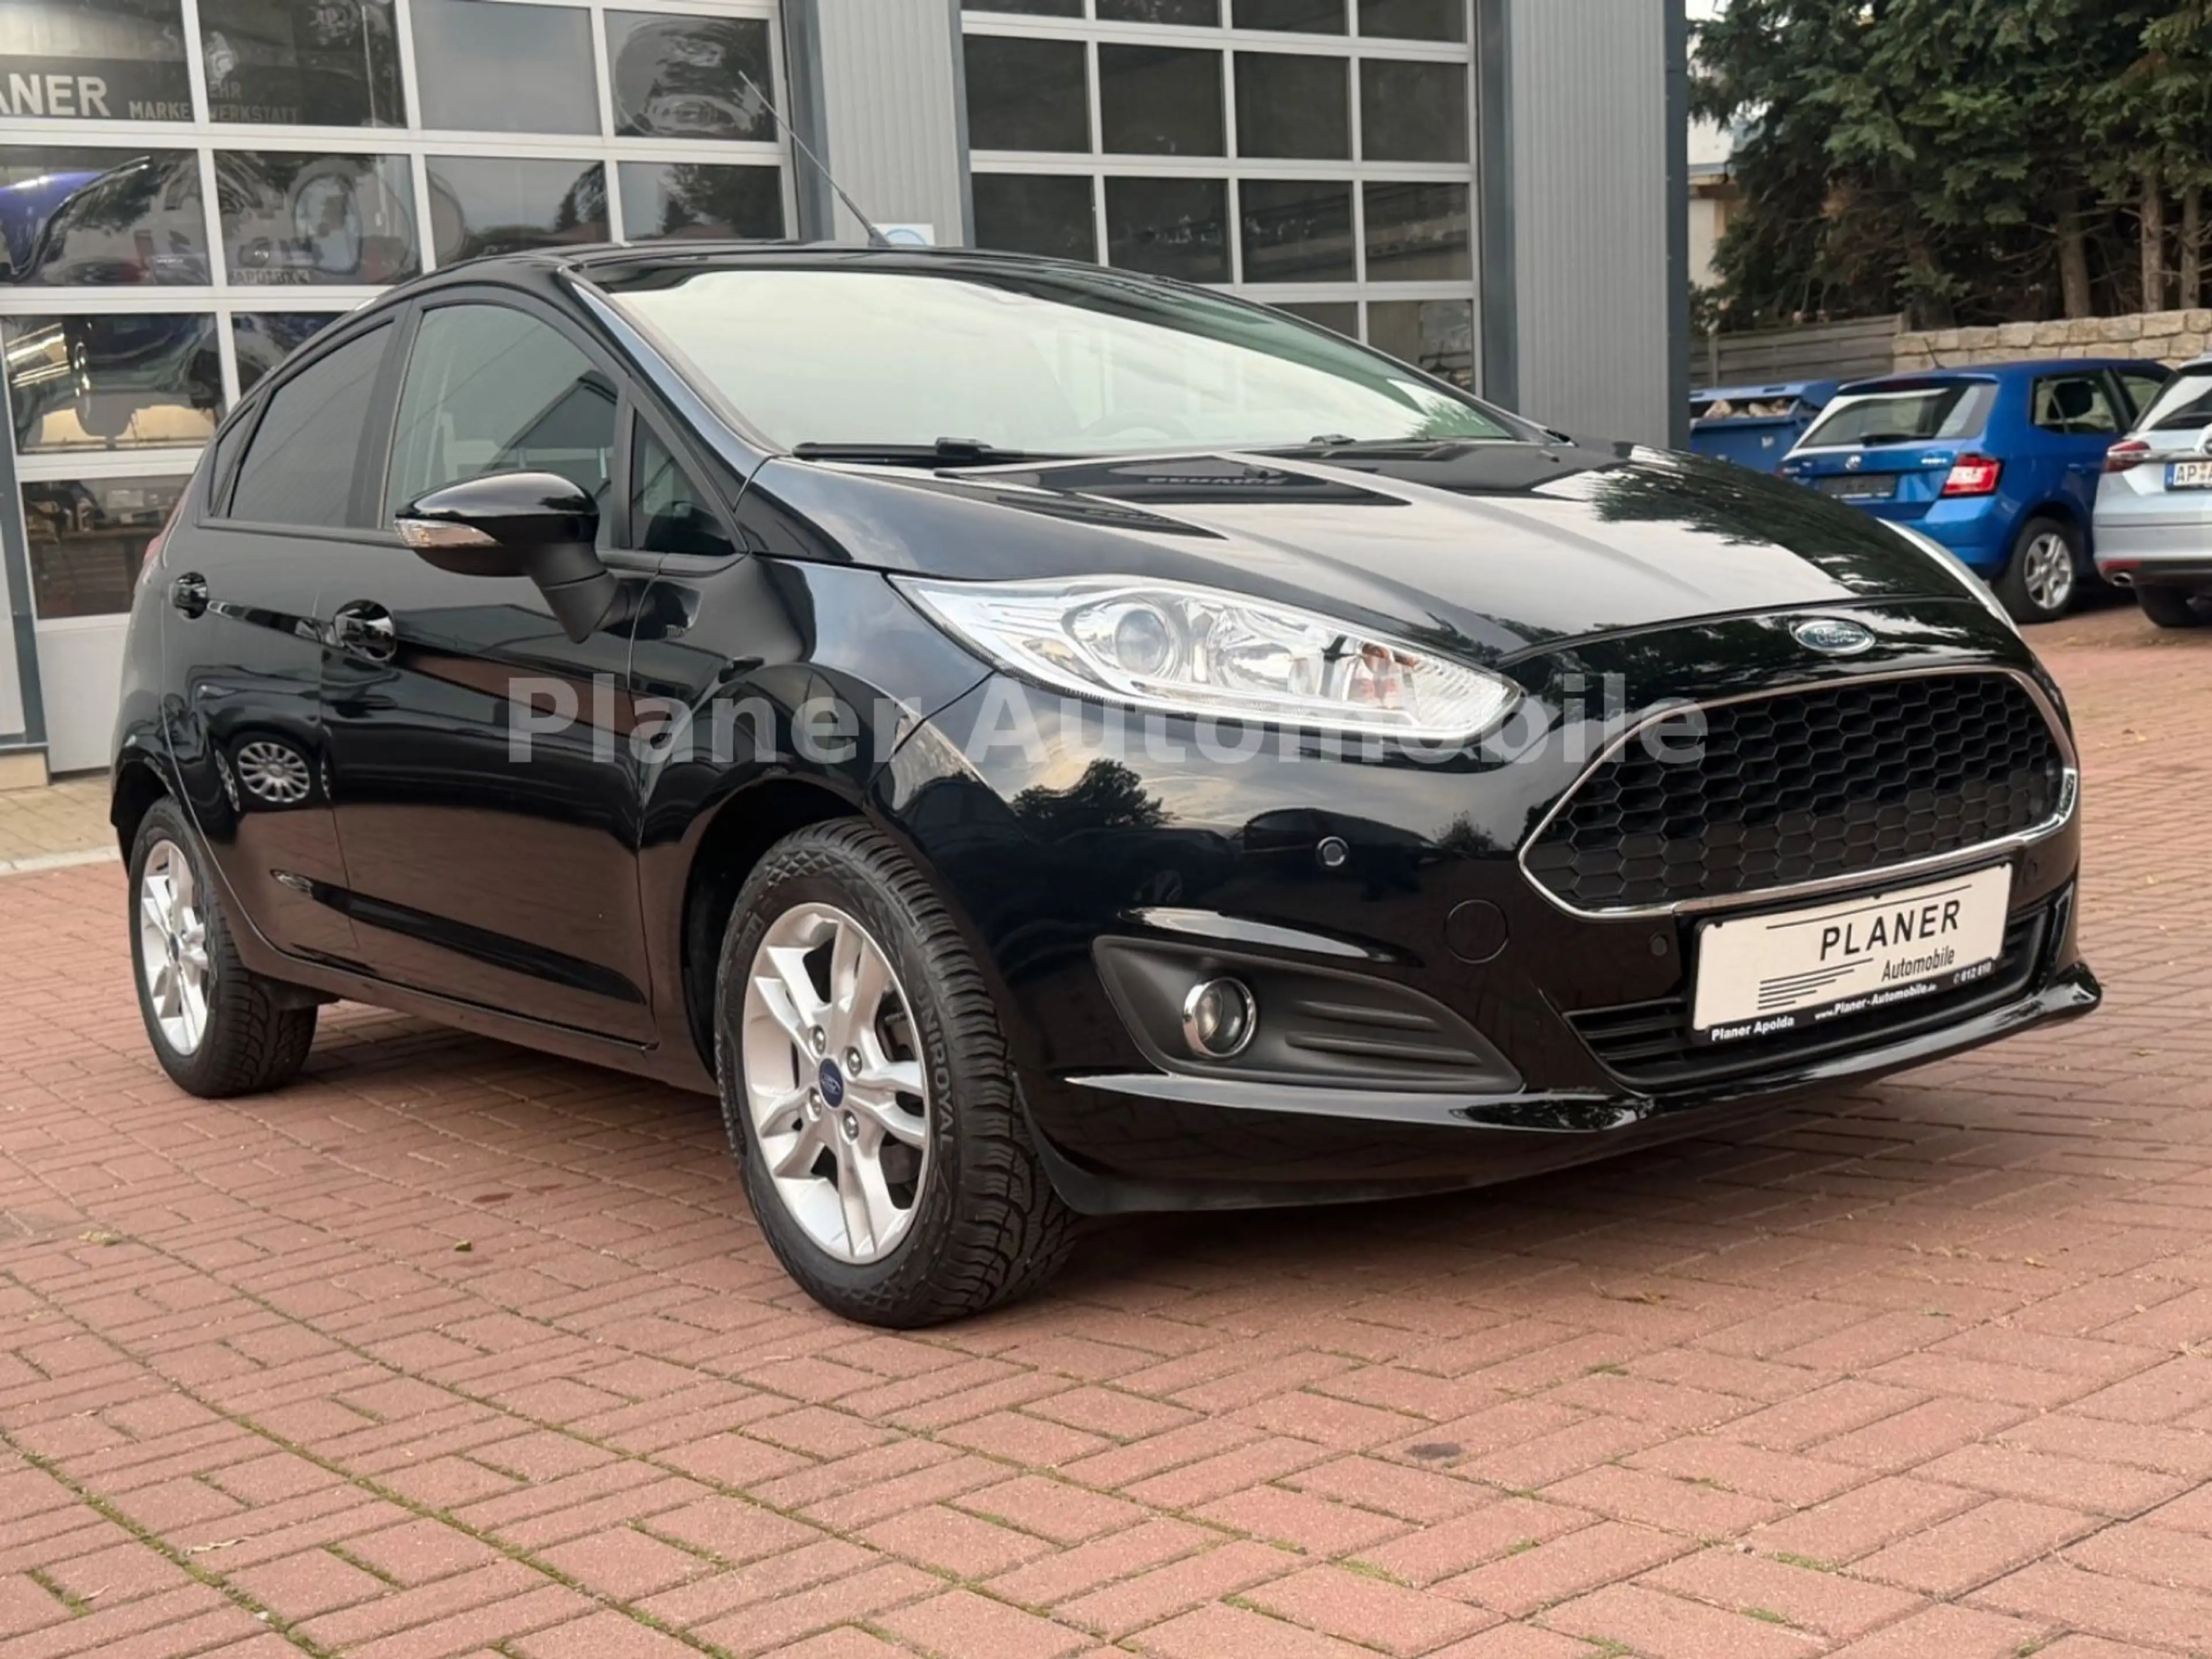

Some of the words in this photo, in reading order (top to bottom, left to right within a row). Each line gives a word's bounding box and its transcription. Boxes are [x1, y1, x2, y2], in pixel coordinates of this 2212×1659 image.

[1819, 899, 1961, 962] PLANER
[1881, 945, 1955, 983] Automobile
[1711, 1024, 1752, 1042] Planer
[1753, 1016, 1795, 1035] Apolda
[914, 980, 955, 1151] UNIROYAL
